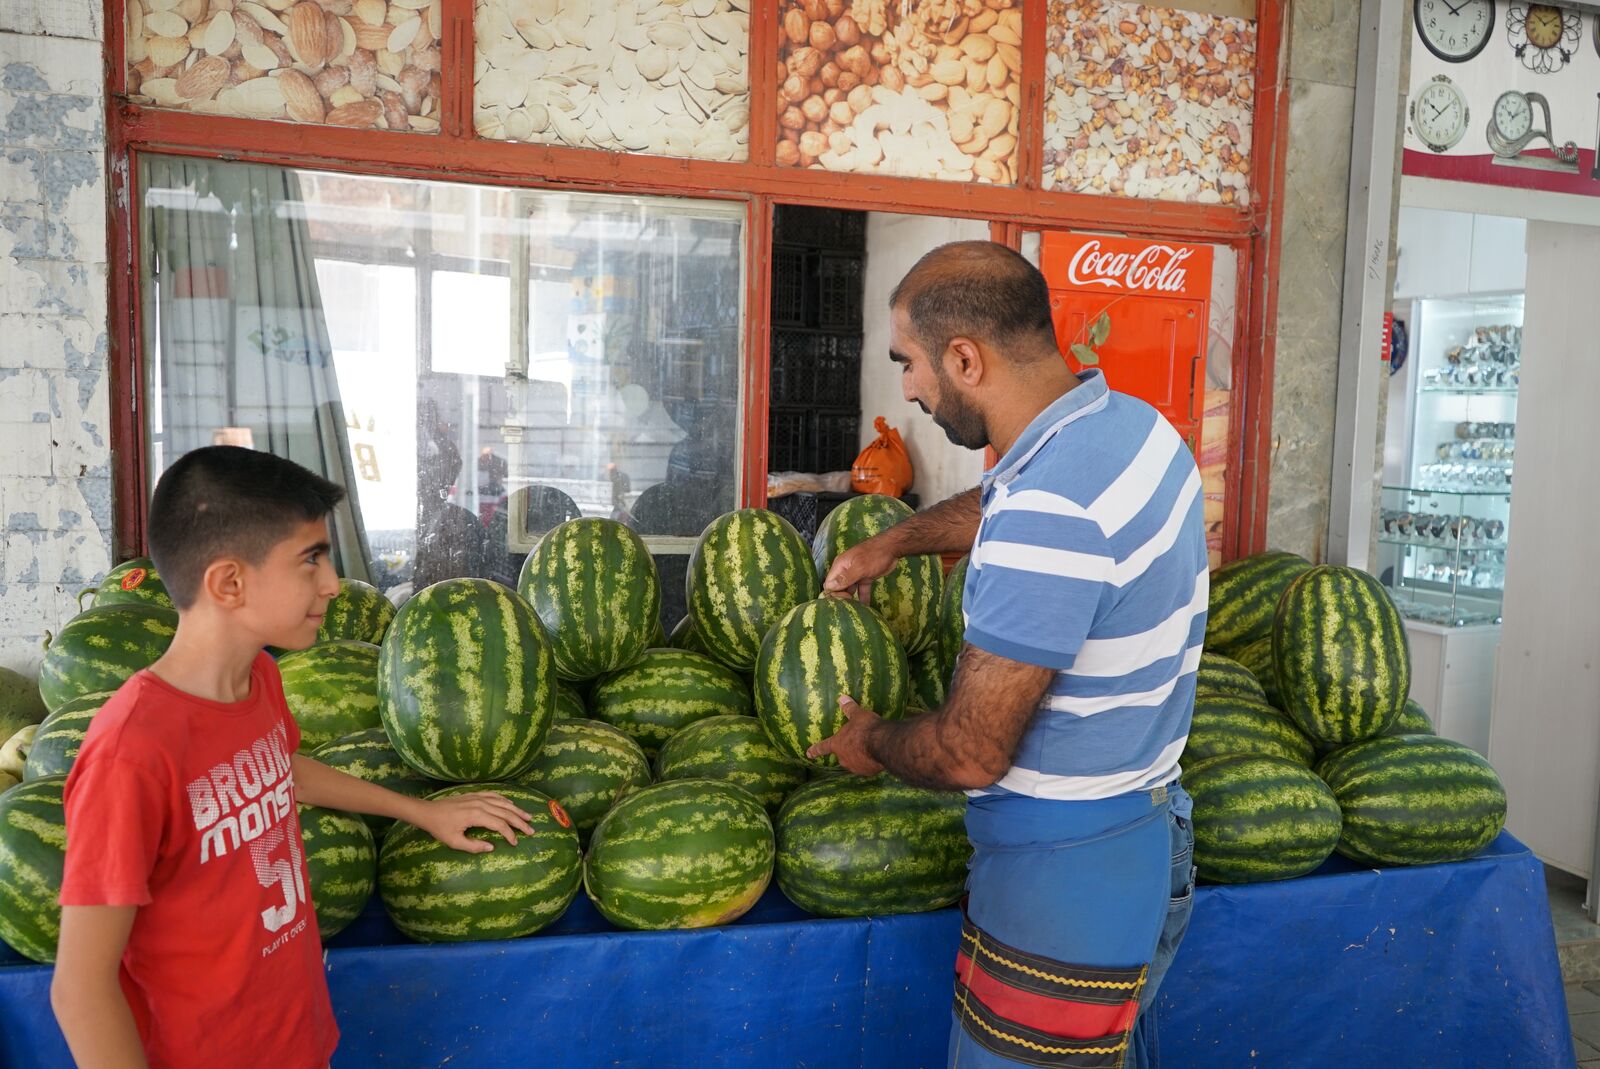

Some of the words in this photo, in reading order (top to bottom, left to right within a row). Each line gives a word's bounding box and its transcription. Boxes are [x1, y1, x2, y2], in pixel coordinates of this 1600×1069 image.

[1068, 240, 1194, 292] Coca-Cola
[262, 937, 281, 957] PLAY
[281, 931, 289, 945] IT
